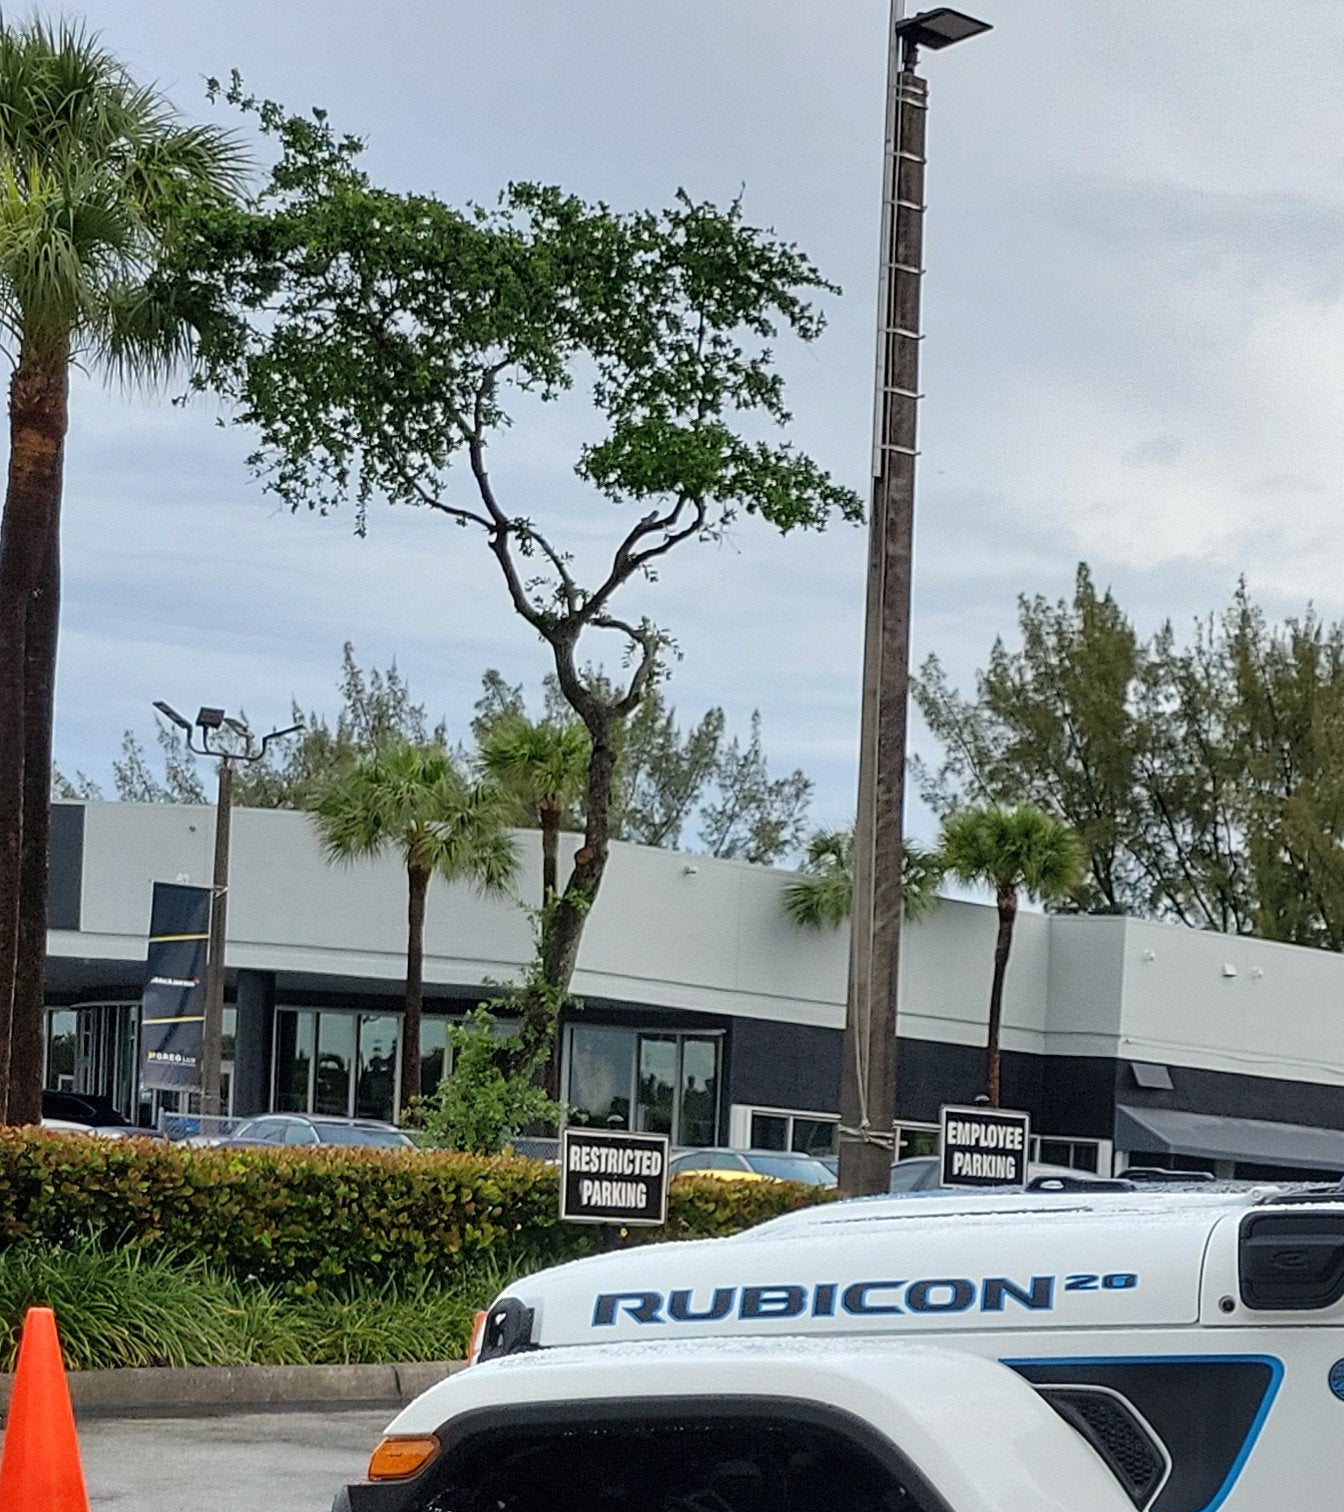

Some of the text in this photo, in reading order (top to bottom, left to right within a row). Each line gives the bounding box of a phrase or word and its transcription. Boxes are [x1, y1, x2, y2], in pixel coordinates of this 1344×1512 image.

[947, 1121, 1023, 1150] EMPLOYEE
[569, 1145, 662, 1177] RESTRICTED
[953, 1151, 1016, 1179] PARKING
[581, 1179, 647, 1209] PARKING
[591, 1275, 1056, 1328] RUBICON
